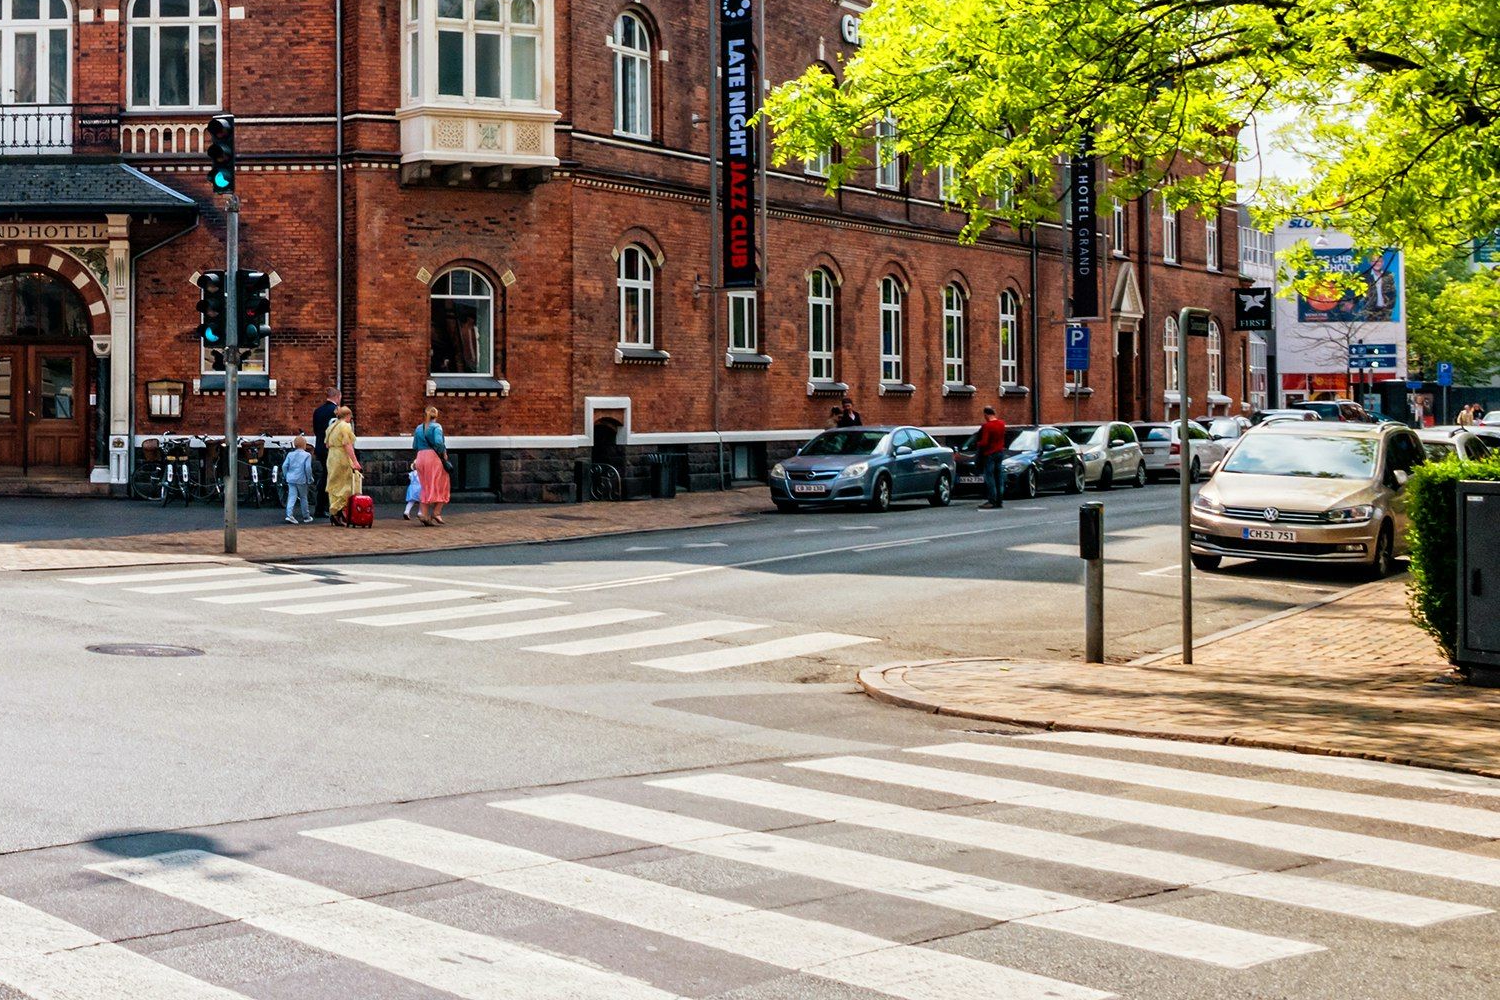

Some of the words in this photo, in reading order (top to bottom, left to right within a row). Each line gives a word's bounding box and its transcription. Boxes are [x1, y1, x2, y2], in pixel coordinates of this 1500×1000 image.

[727, 38, 746, 89] LATE
[728, 94, 748, 157] NIGHT
[729, 161, 748, 209] JAZZ
[1077, 175, 1089, 222] HOTEL
[28, 225, 103, 238] HOTEL
[730, 216, 748, 269] CLUB
[1078, 228, 1090, 276] GRAND
[1071, 330, 1085, 347] P
[1240, 319, 1267, 327] FIRST
[1440, 363, 1449, 373] P
[1249, 529, 1262, 538] CH
[1264, 530, 1275, 539] 51
[1278, 530, 1294, 541] 751
